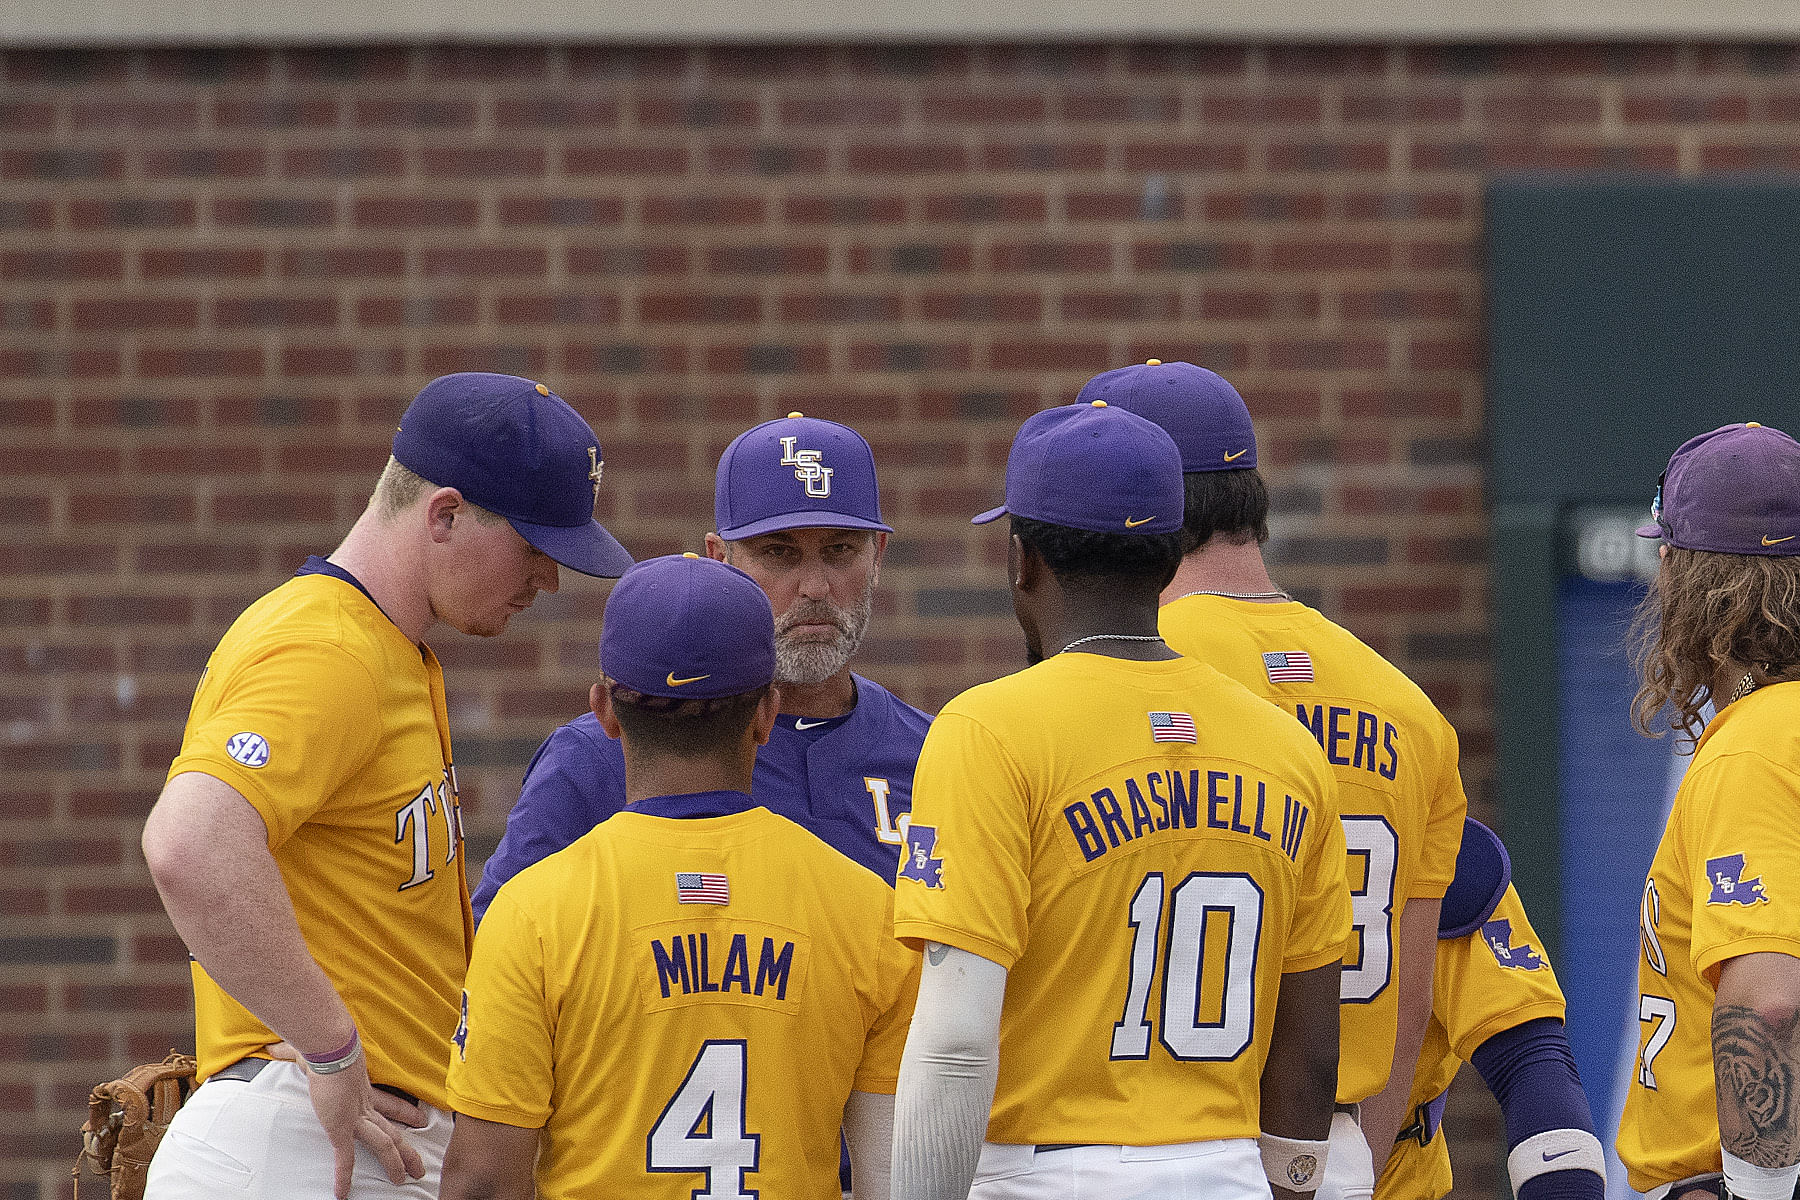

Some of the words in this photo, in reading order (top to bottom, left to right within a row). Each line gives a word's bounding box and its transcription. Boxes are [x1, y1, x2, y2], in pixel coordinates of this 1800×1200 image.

[780, 436, 833, 498] LSU
[226, 731, 268, 767] SEC
[1063, 769, 1272, 862] BRASWELL
[1281, 794, 1309, 863] III
[1715, 872, 1735, 894] LSU
[650, 932, 795, 1001] MILAM
[1109, 871, 1264, 1062] 10
